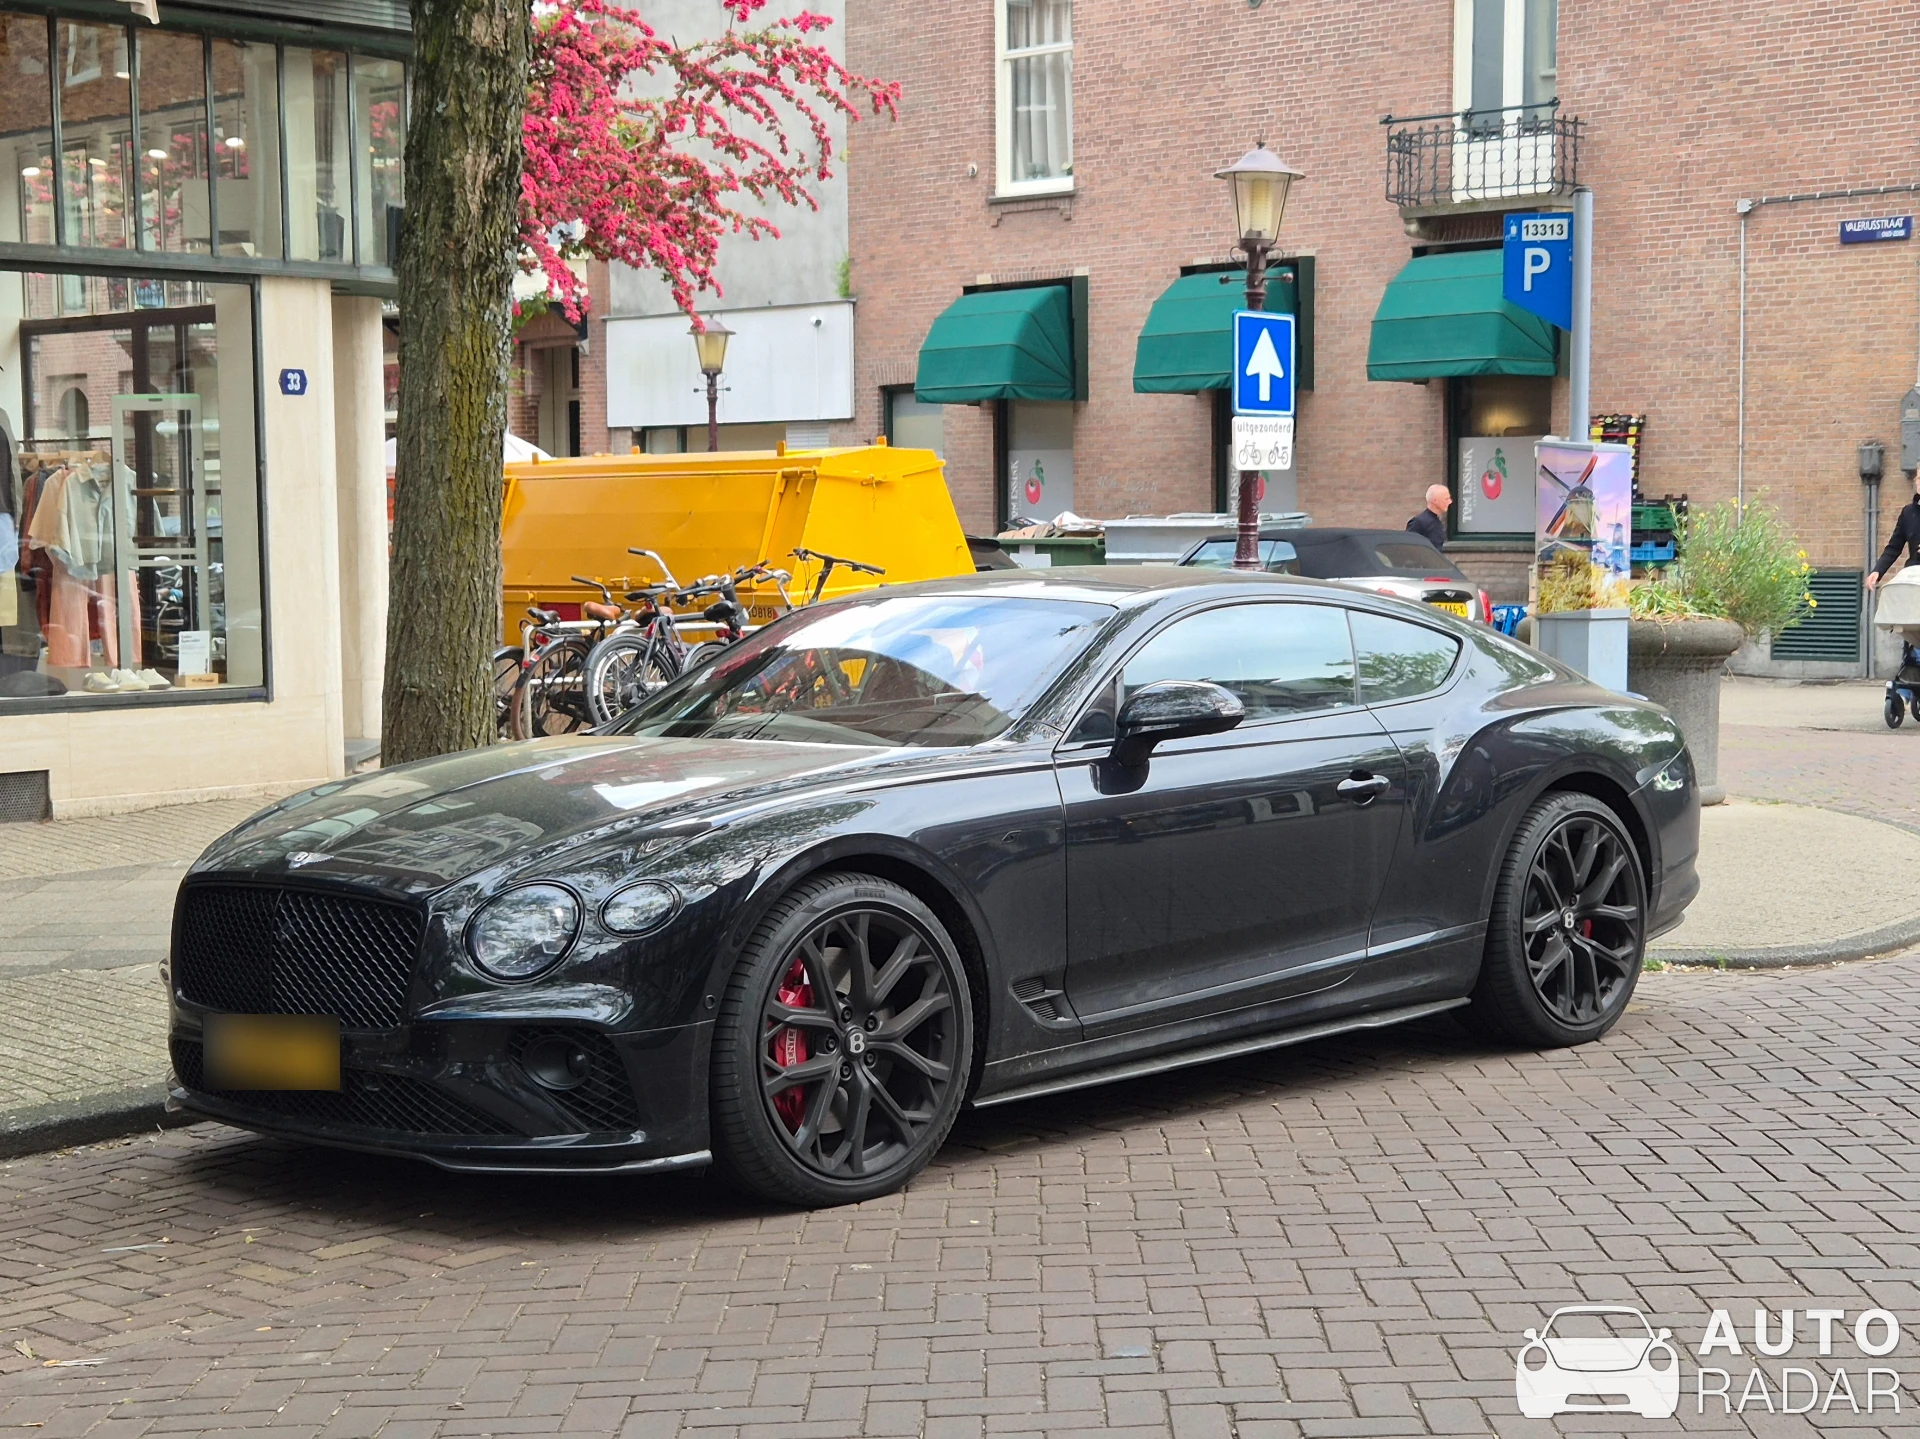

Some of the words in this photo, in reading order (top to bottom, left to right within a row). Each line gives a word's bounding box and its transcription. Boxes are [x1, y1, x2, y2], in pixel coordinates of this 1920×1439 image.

[1523, 224, 1564, 236] 13313
[1845, 218, 1904, 232] VALERIUSSTRAAT
[1523, 247, 1551, 292] P
[287, 372, 300, 391] 33
[1237, 422, 1291, 435] uitgezonderd
[1462, 448, 1474, 494] ENSINK
[1011, 503, 1019, 520] OM
[1462, 497, 1472, 523] TOM
[1564, 912, 1575, 928] B
[849, 1032, 865, 1053] B
